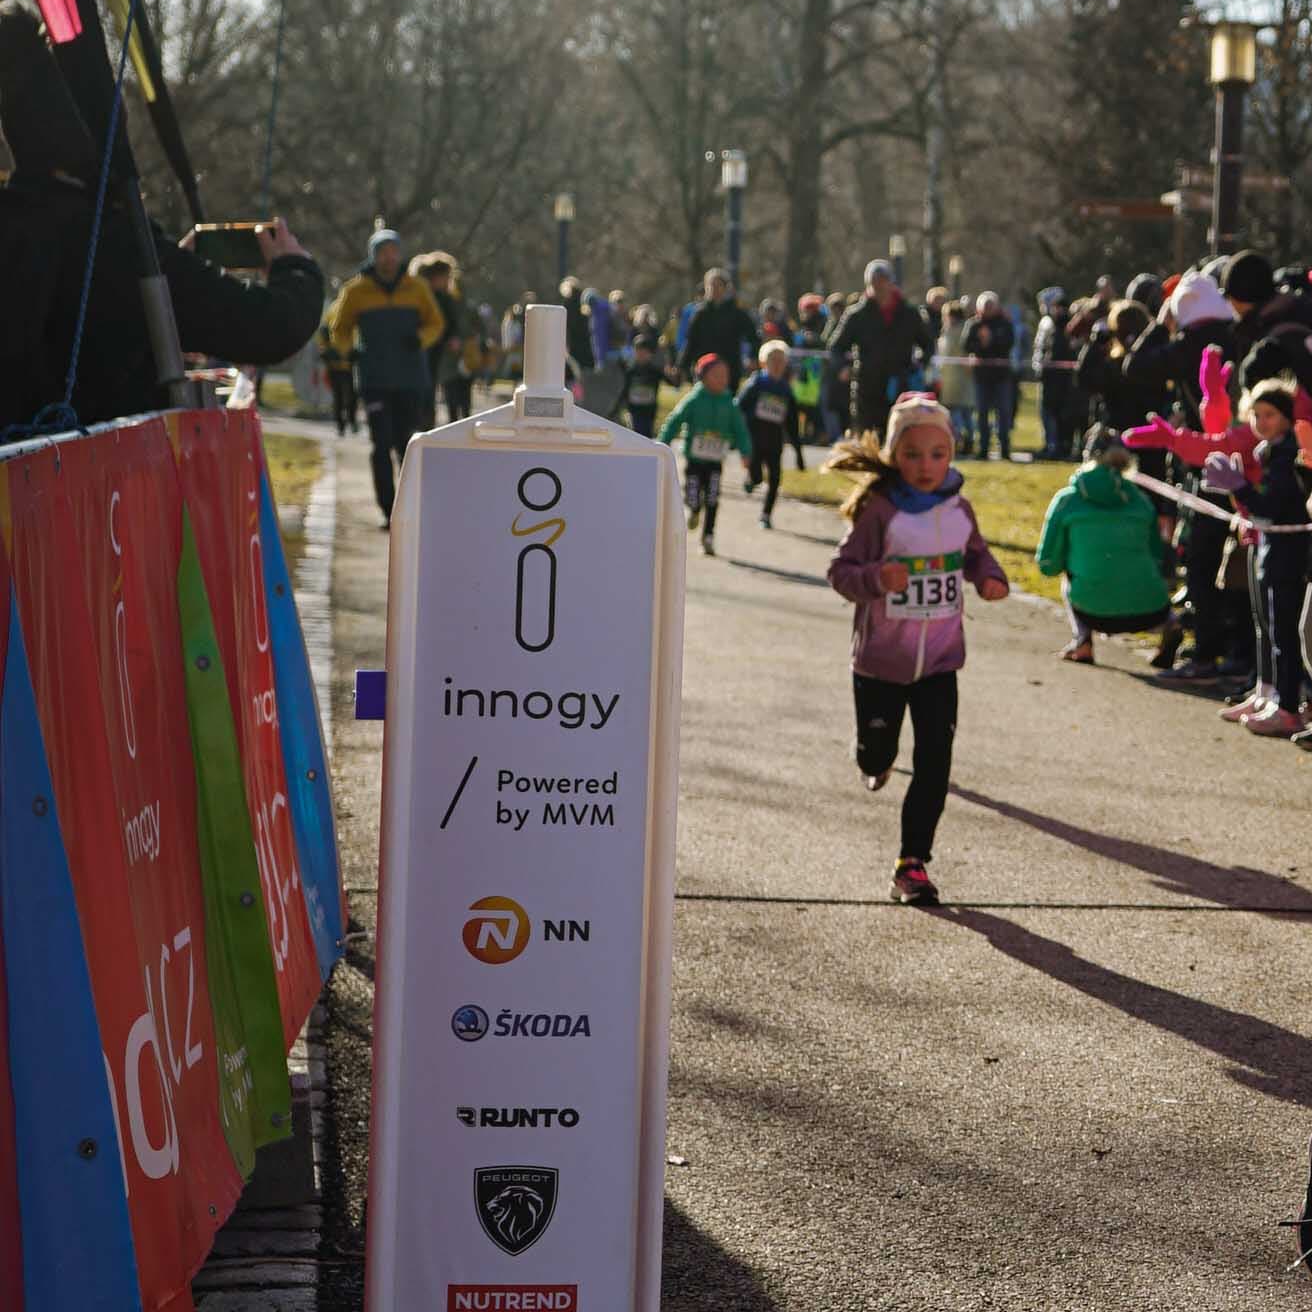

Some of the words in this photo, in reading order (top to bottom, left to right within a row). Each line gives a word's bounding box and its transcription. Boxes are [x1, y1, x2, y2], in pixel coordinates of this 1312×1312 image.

[442, 677, 620, 730] innogy
[497, 769, 618, 795] Powered
[496, 800, 530, 831] by
[542, 802, 615, 826] MVM
[543, 919, 591, 942] NN
[493, 1008, 592, 1037] ŠKODA
[480, 1107, 580, 1128] RUNTO
[482, 1174, 551, 1183] PEUGEOT
[455, 1291, 572, 1311] NUTREND
